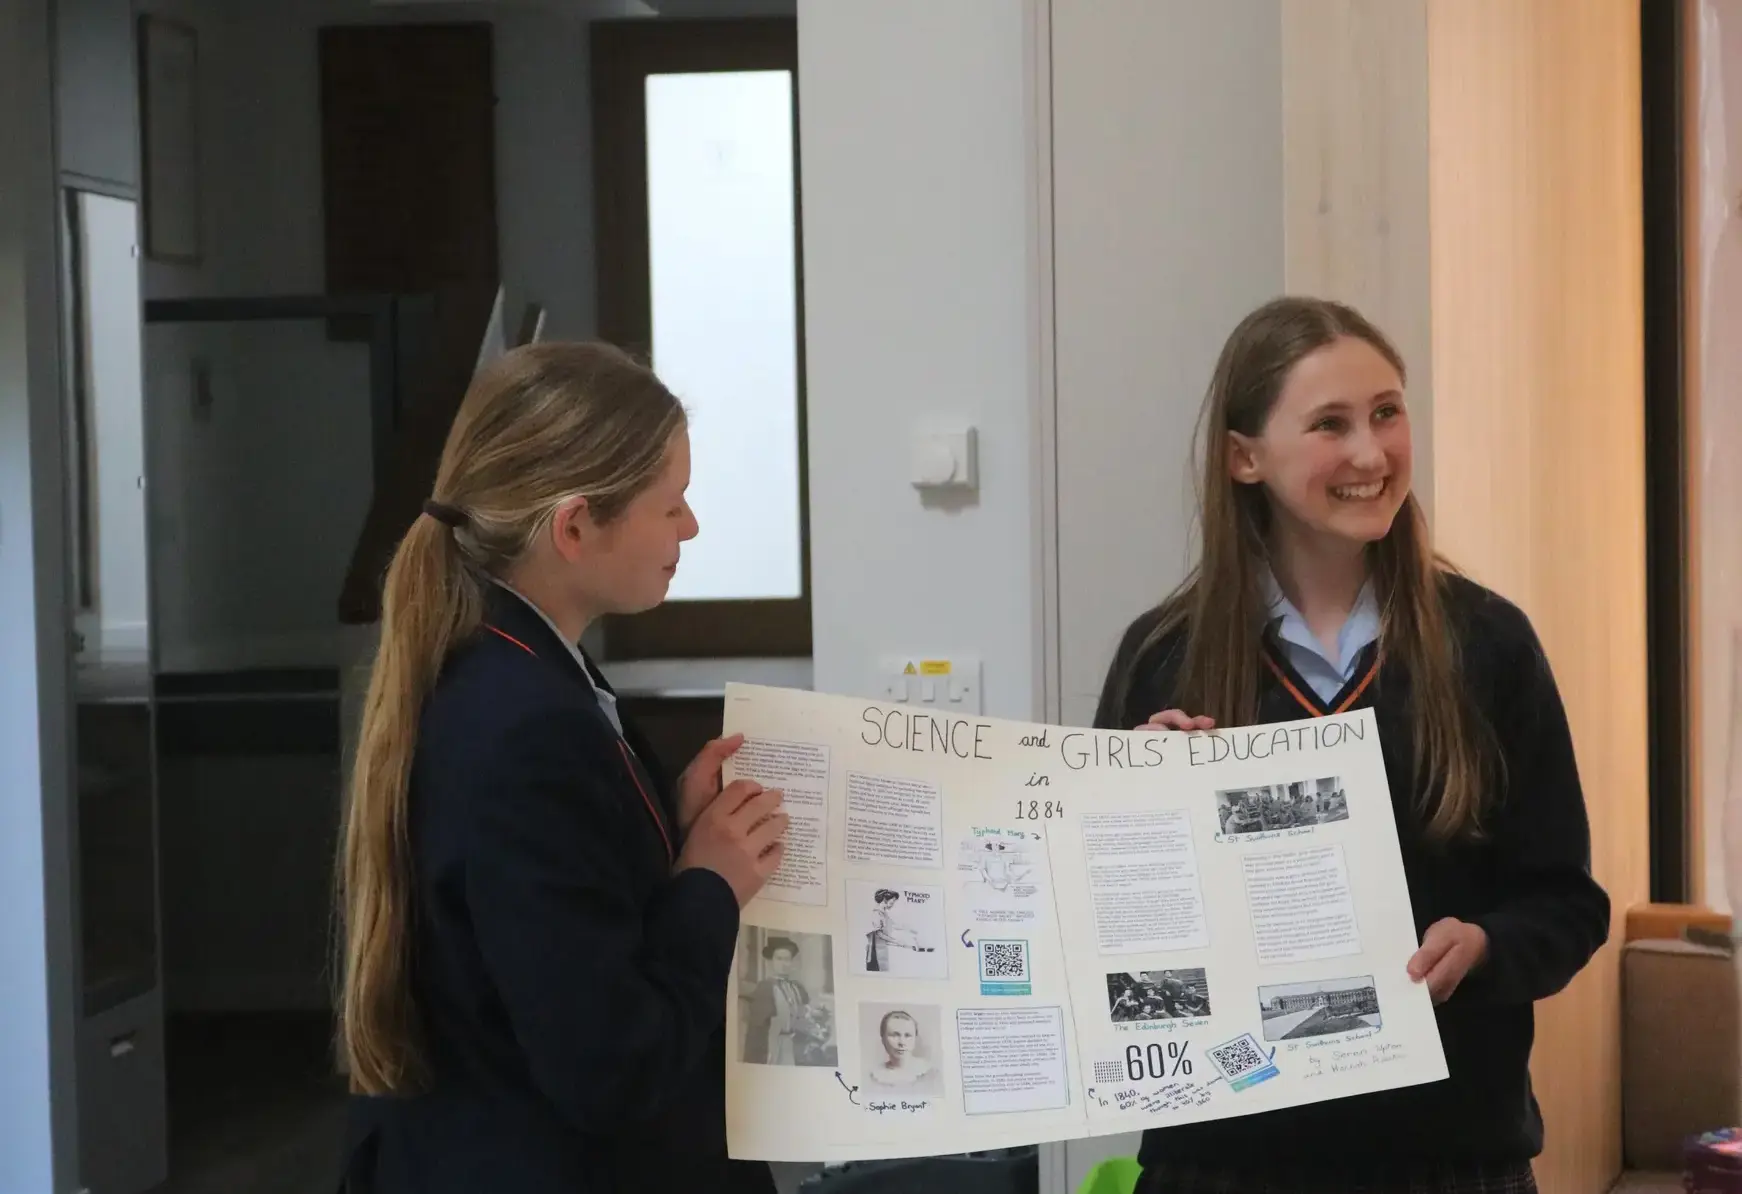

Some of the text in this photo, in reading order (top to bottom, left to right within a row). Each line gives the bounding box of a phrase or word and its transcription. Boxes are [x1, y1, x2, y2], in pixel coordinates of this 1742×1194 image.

[861, 706, 992, 760] SCIENCE
[1018, 729, 1050, 749] and
[1061, 733, 1168, 770] GIRLS'
[1188, 719, 1365, 767] EDUCATION
[1024, 772, 1049, 787] in
[1015, 800, 1064, 820] 1884
[1007, 830, 1025, 840] Mary
[1228, 835, 1240, 843] St
[1114, 1019, 1209, 1032] The Edinburgh Seven
[1125, 1040, 1193, 1081] 60%
[1098, 1097, 1109, 1107] In
[1120, 1099, 1137, 1110] 60%
[1152, 1083, 1179, 1095] women
[868, 1100, 927, 1114] Sophie Bryant
